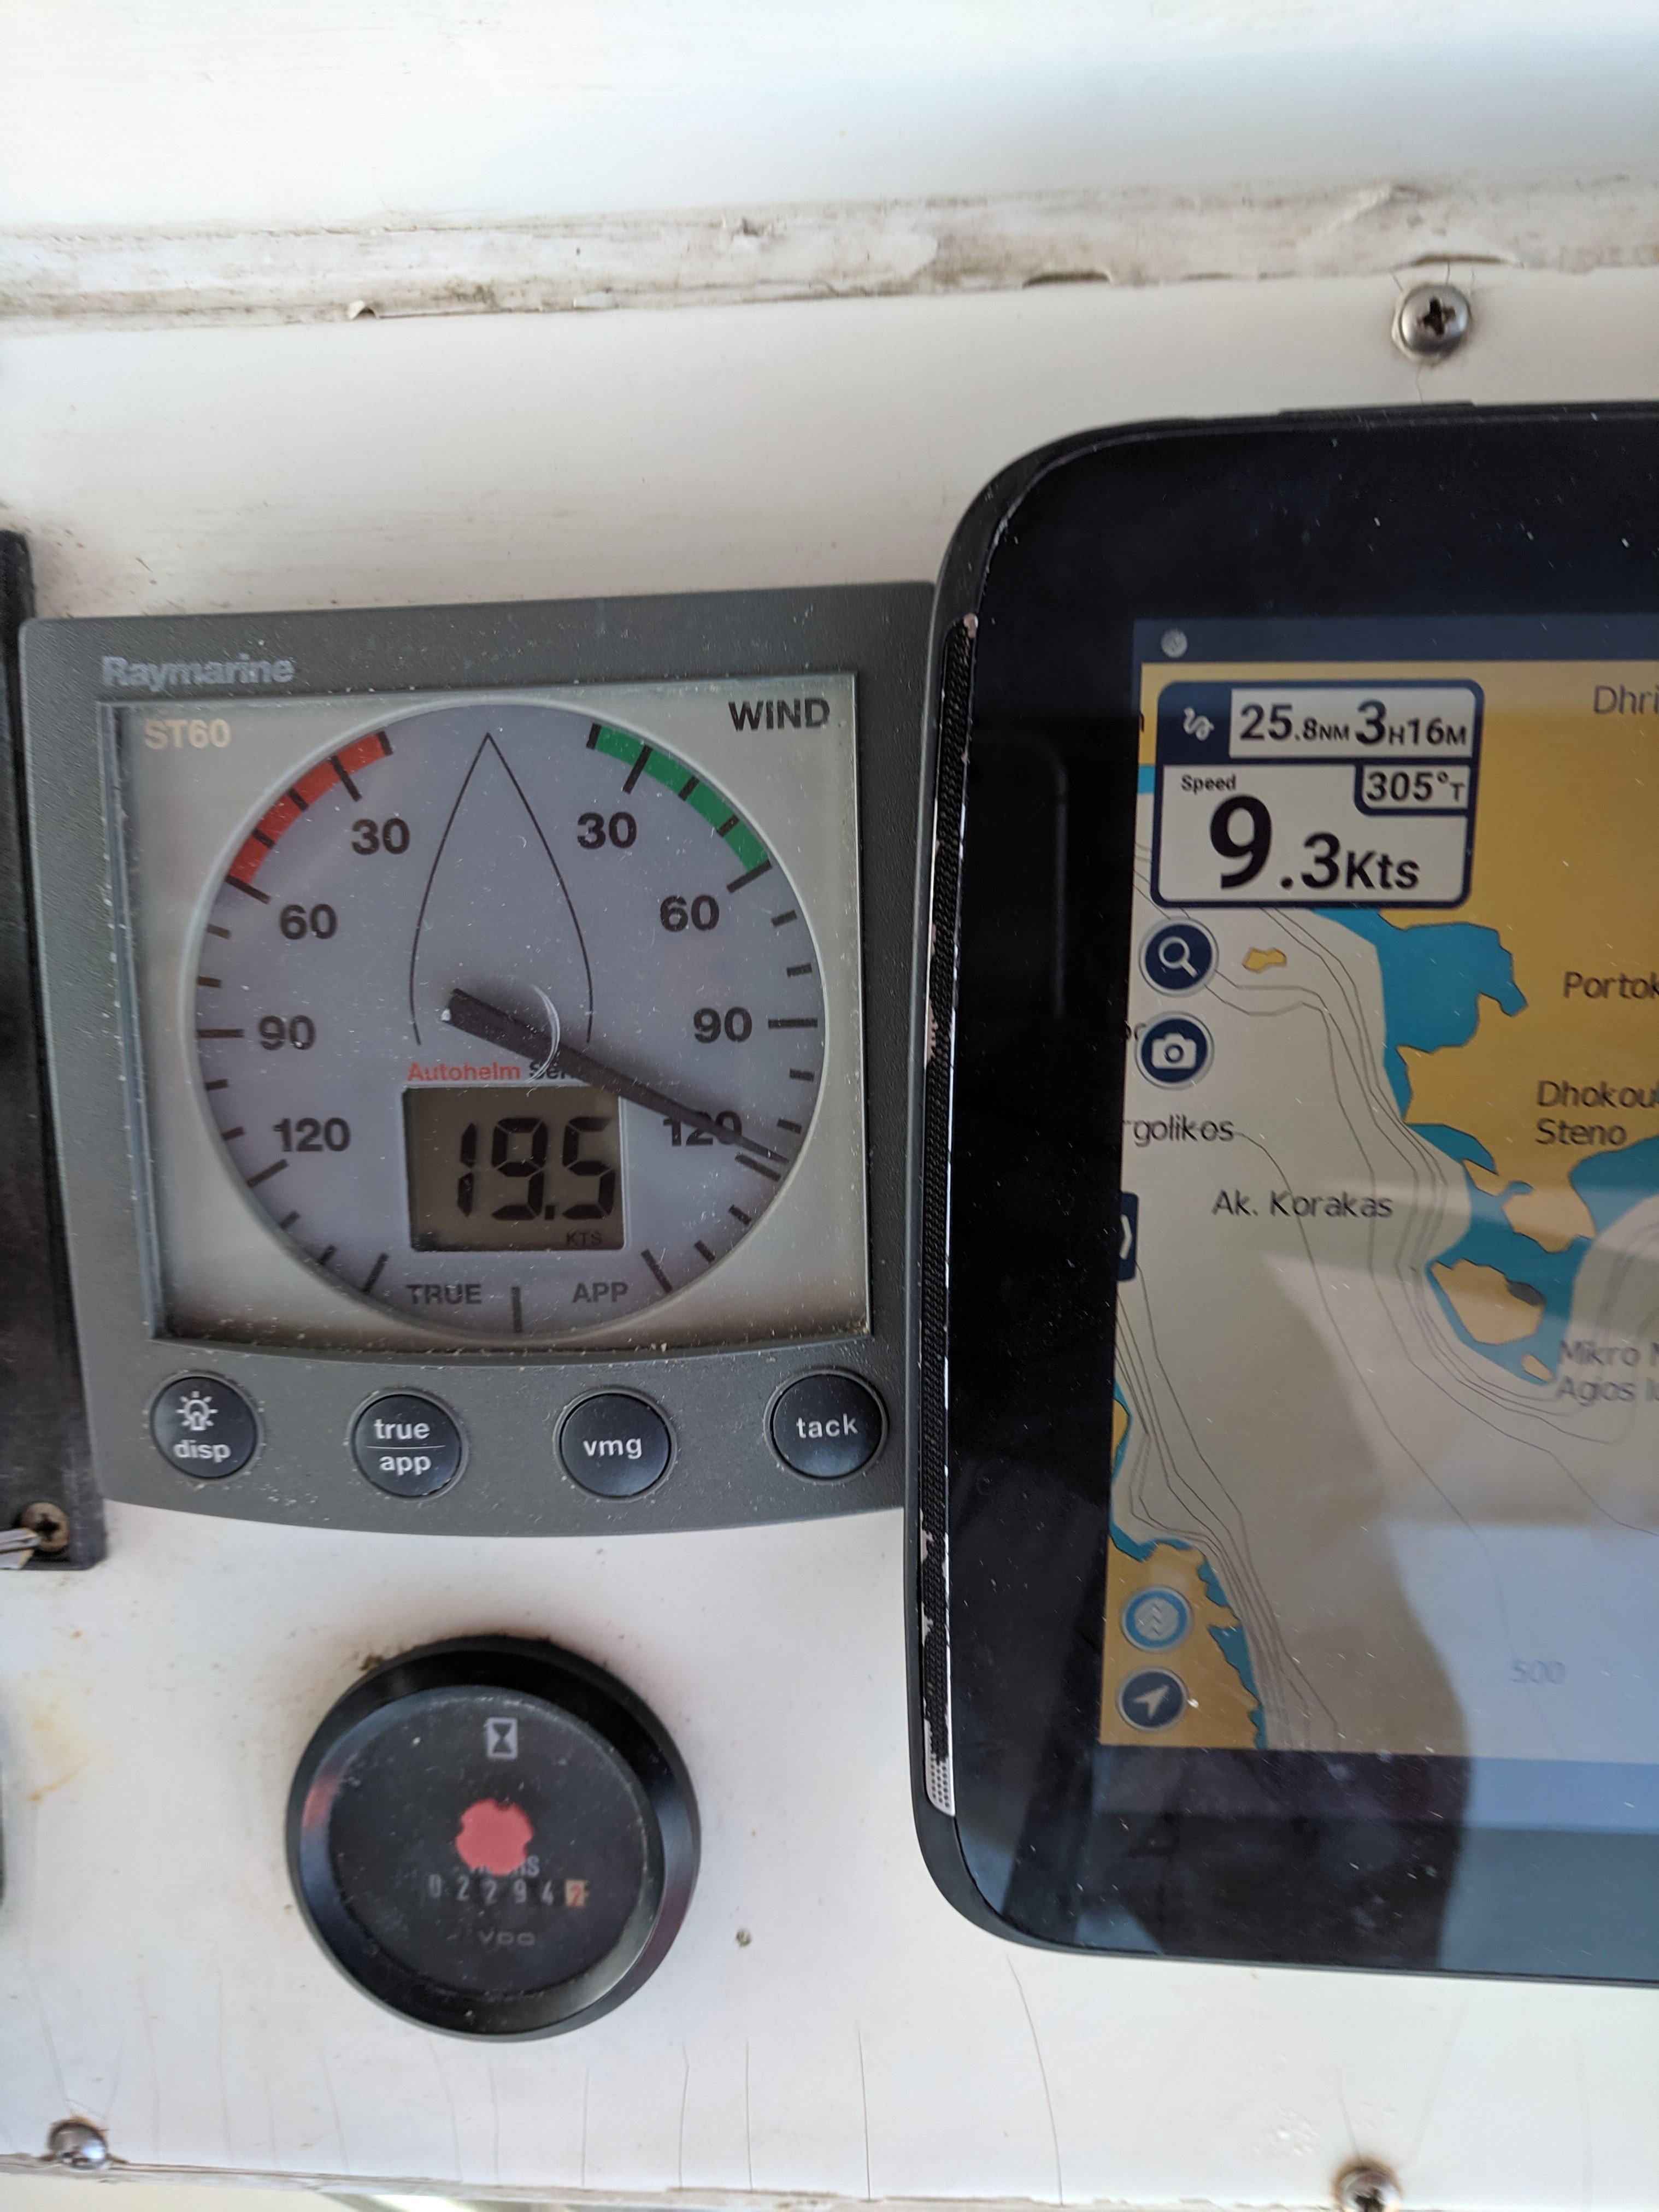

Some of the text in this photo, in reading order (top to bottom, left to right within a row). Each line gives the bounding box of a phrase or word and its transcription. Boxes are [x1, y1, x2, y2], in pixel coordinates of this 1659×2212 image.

[102, 655, 295, 691] Raymarine
[728, 698, 831, 731] WIND
[143, 718, 232, 750] ST60
[1181, 773, 1237, 795] Speed
[351, 817, 410, 856] 30
[577, 811, 637, 850] 30
[279, 903, 338, 940] 60
[660, 895, 720, 932] 60
[258, 1015, 316, 1050] 90
[693, 1007, 752, 1044] 90
[407, 1062, 522, 1081] Autohelm
[272, 1117, 351, 1152] 120
[663, 1110, 742, 1146] 120
[1536, 1117, 1627, 1146] Steno
[457, 1116, 616, 1221] 19.5
[1211, 1189, 1394, 1219] Ak. Korakas
[565, 1232, 603, 1246] KTS
[406, 1284, 482, 1305] TRUE
[572, 1282, 628, 1304] APP
[1560, 1339, 1641, 1367] Mikro
[1556, 1375, 1638, 1407] Agios
[374, 1418, 431, 1440] true
[796, 1413, 858, 1439] tack
[173, 1439, 231, 1463] disp
[583, 1436, 643, 1460] vmg
[379, 1452, 432, 1475] app
[1509, 1658, 1567, 1685] 500
[478, 1931, 536, 1946] VDO
